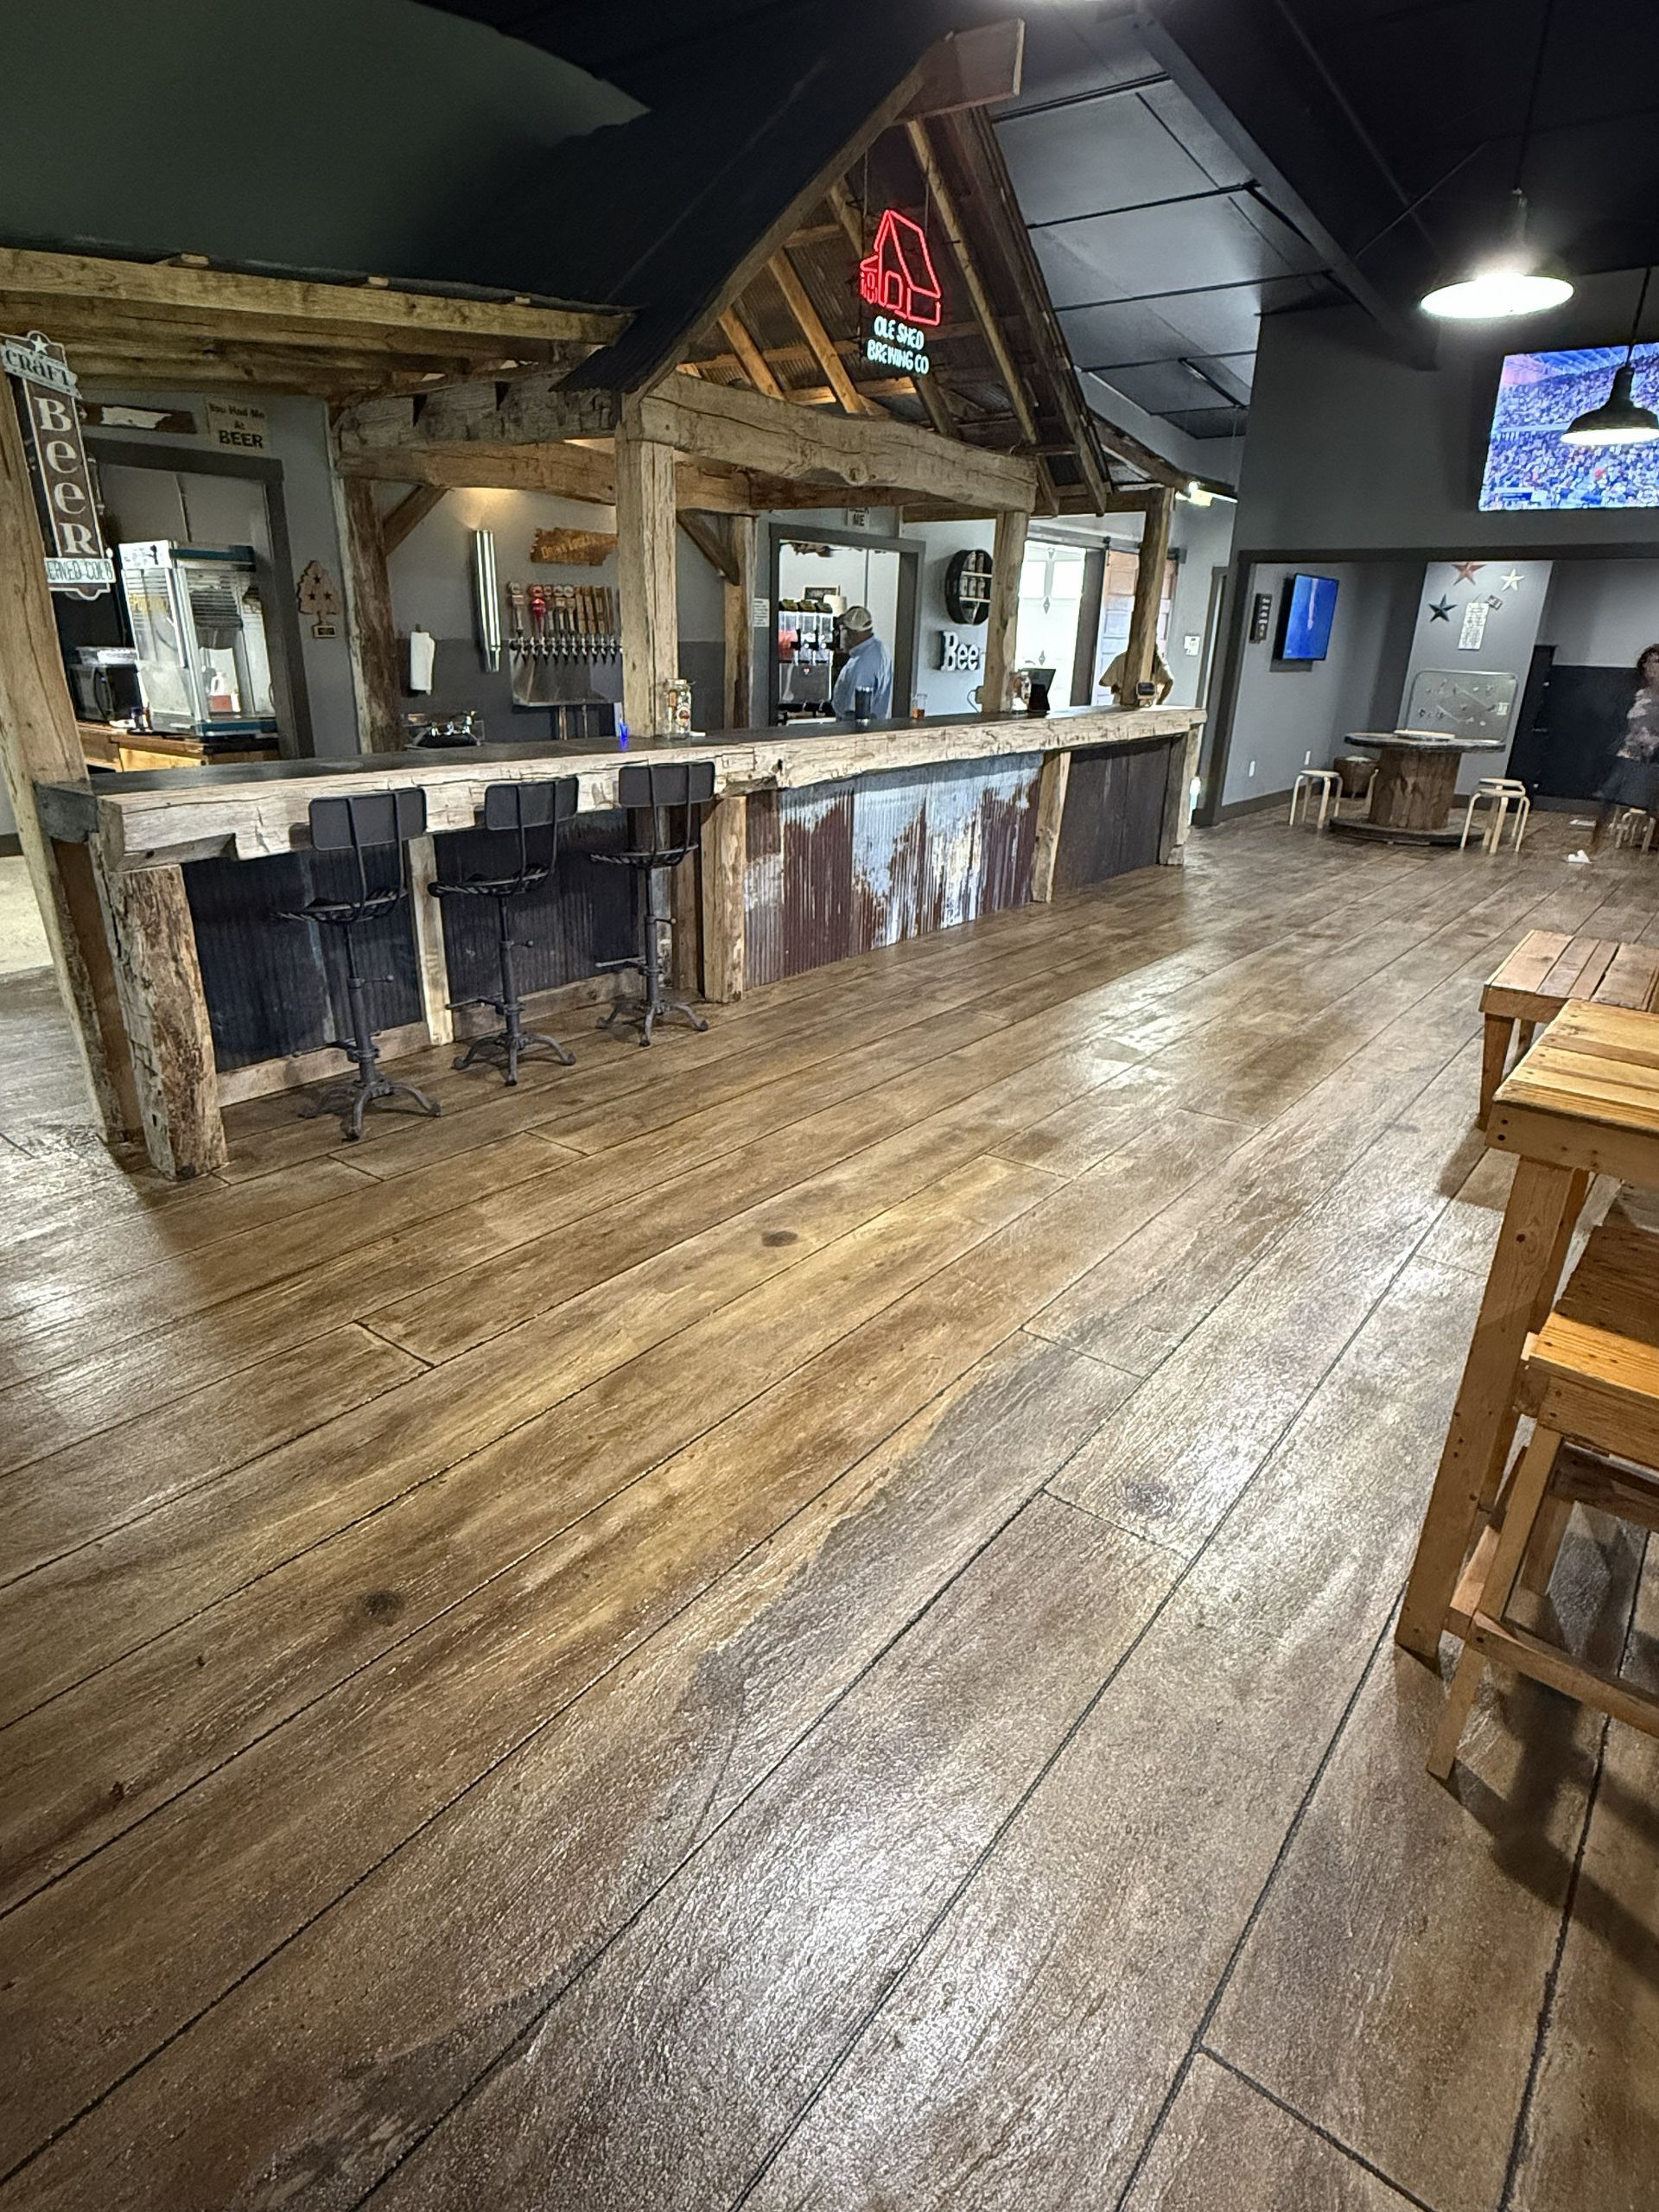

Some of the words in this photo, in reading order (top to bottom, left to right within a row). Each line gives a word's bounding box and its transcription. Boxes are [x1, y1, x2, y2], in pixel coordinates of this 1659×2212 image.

[874, 315, 896, 340] OLE
[896, 323, 925, 350] SHED
[868, 339, 913, 371] BREWING
[914, 354, 930, 374] CO
[208, 403, 226, 414] You
[228, 404, 248, 416] Had
[219, 429, 264, 448] BEER
[47, 561, 82, 581] ERVED
